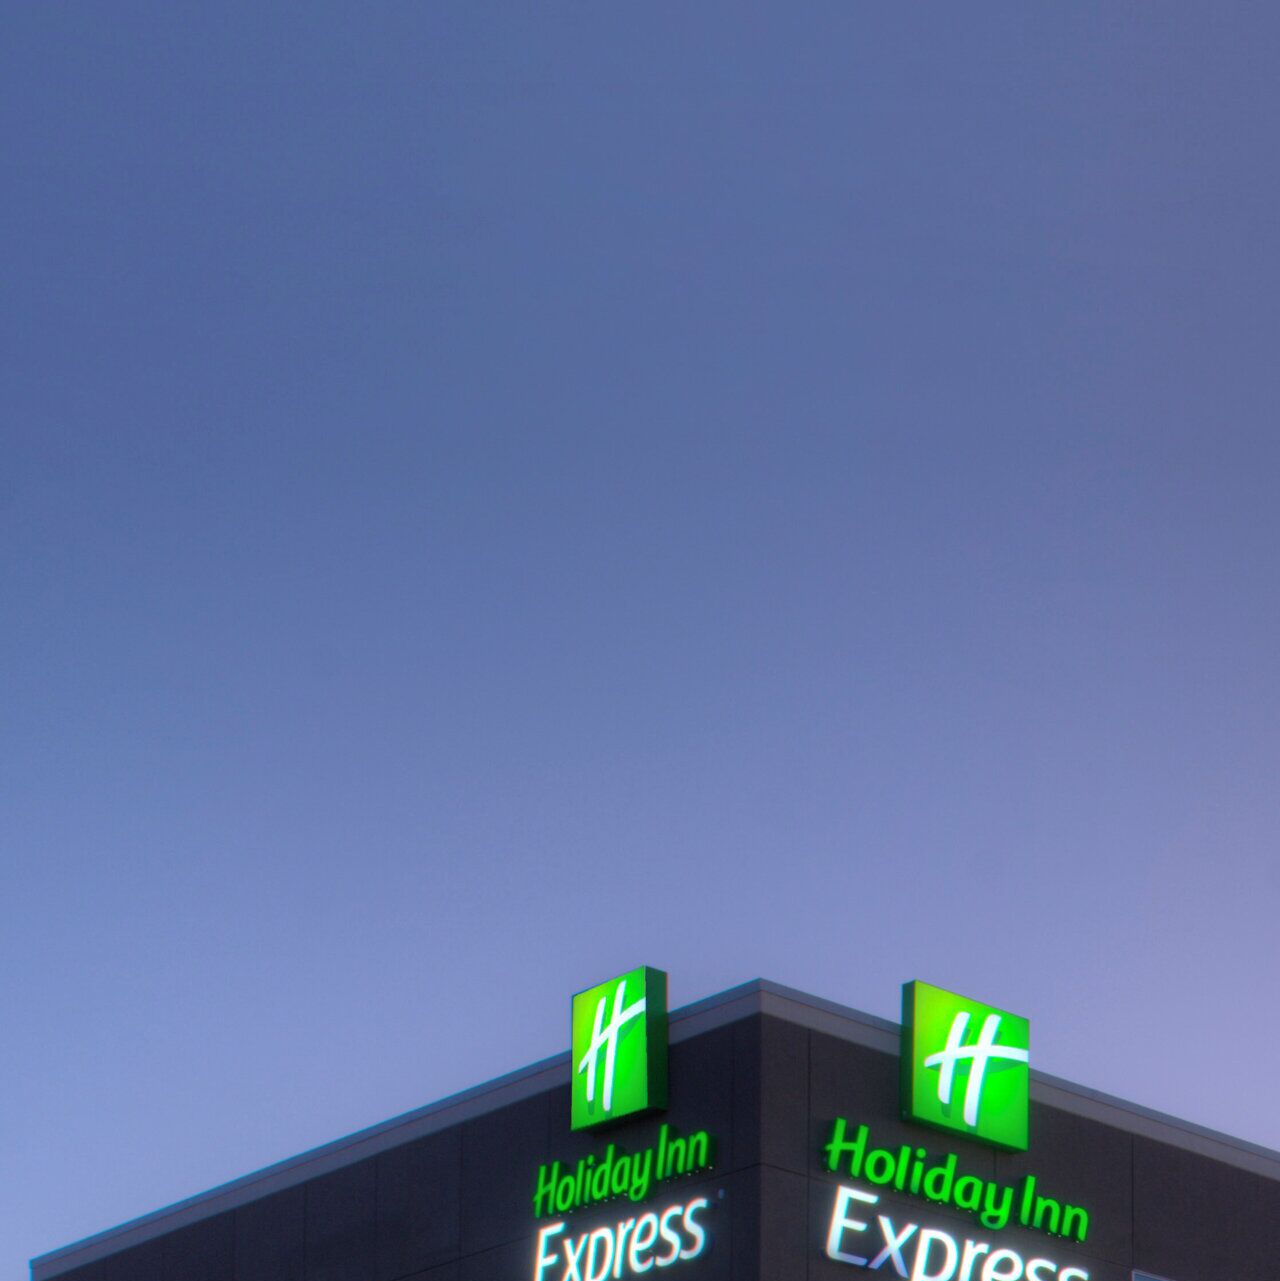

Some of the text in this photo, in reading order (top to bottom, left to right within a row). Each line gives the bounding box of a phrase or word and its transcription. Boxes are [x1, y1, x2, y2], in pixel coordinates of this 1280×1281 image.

[533, 1123, 709, 1219] Holiday Inn
[824, 1117, 1090, 1242] Holiday Inn
